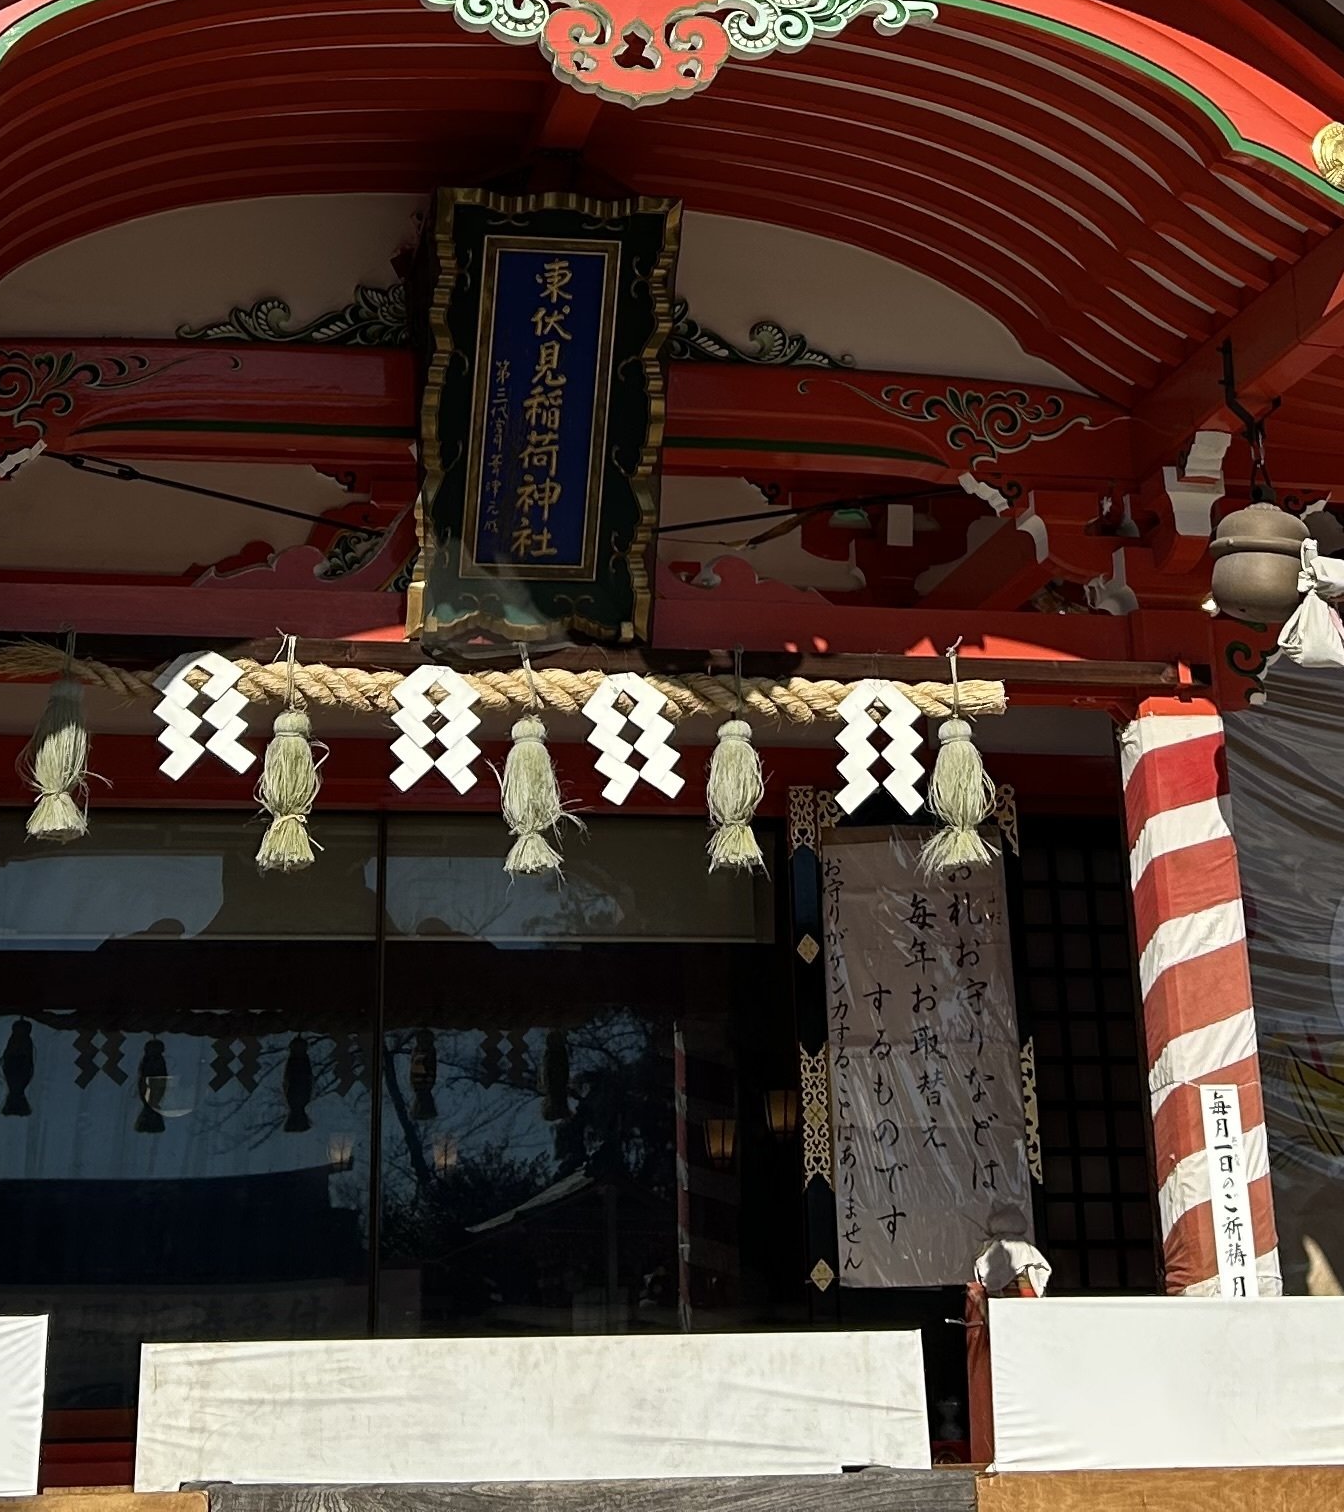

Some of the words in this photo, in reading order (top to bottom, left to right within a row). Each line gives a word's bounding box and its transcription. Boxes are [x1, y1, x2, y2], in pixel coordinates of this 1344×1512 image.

[510, 259, 573, 559] 東伏見稲荷神社
[823, 857, 865, 1271] お守りがケンカすることはありません
[863, 981, 909, 1244] するものです
[905, 892, 948, 1149] 毎年お取替え
